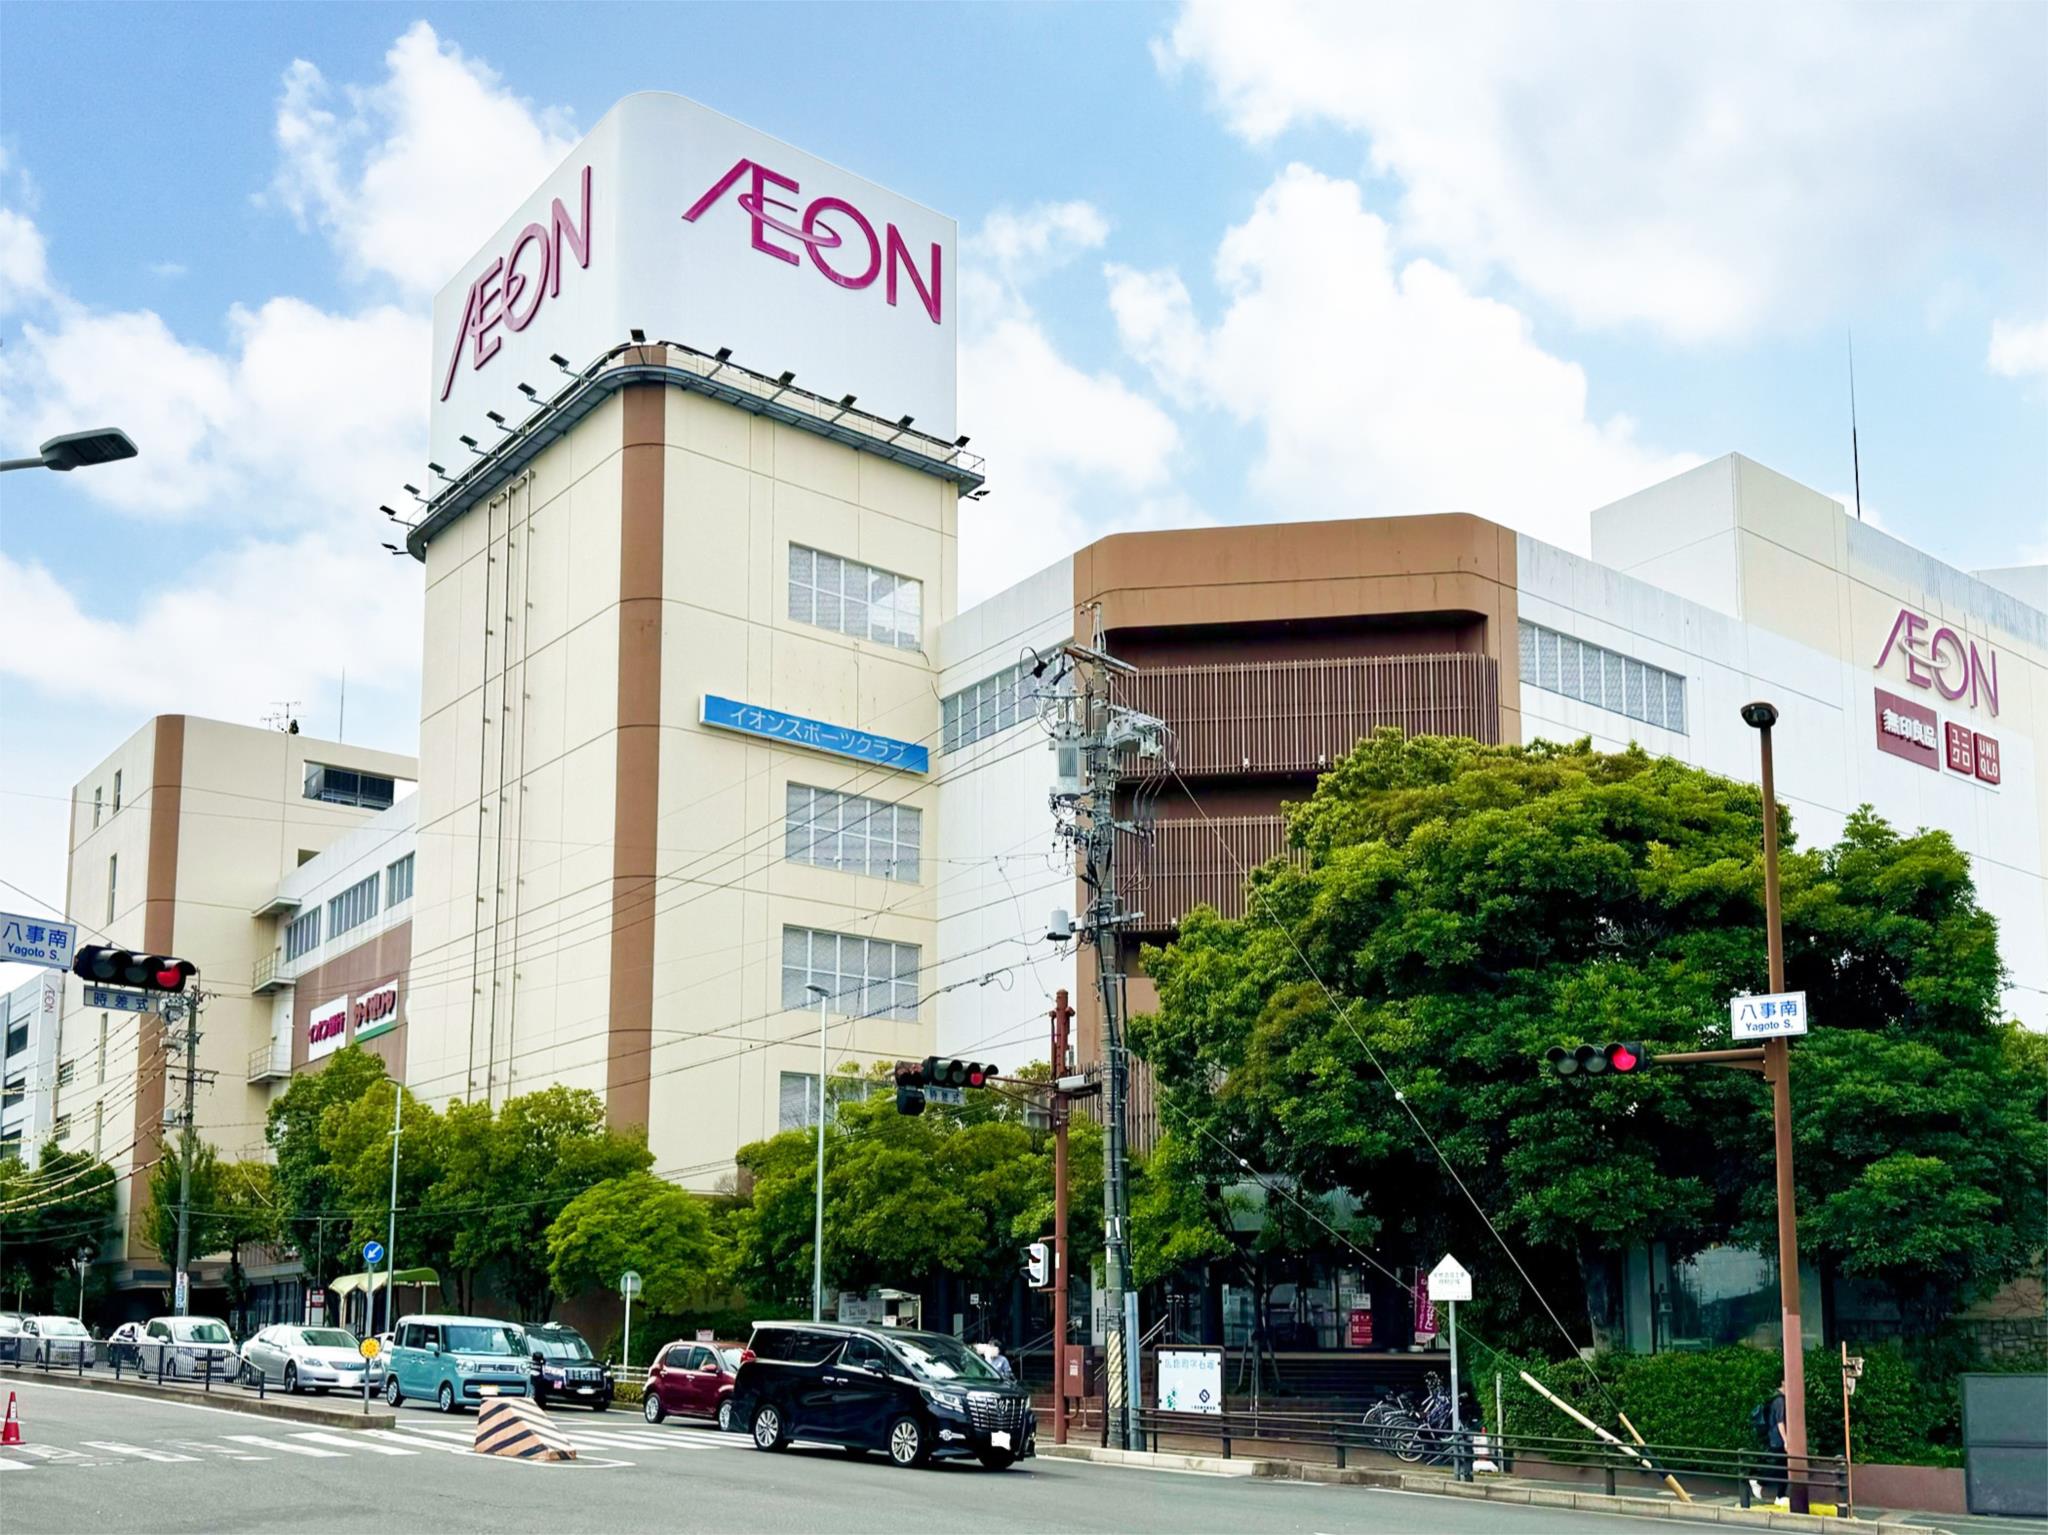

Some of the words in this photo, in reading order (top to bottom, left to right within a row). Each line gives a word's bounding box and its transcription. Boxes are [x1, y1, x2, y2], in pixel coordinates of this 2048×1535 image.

[730, 707, 906, 762] イオンスポーツクラブ
[1882, 708, 1937, 750] 無印良品
[2, 921, 69, 949] 八事南
[7, 942, 45, 958] Yagoto
[49, 949, 60, 962] S.
[93, 992, 149, 1011] 時差式
[1740, 1000, 1797, 1020] 八事南
[1745, 1021, 1780, 1032] Yagoto
[1783, 1019, 1794, 1029] S.
